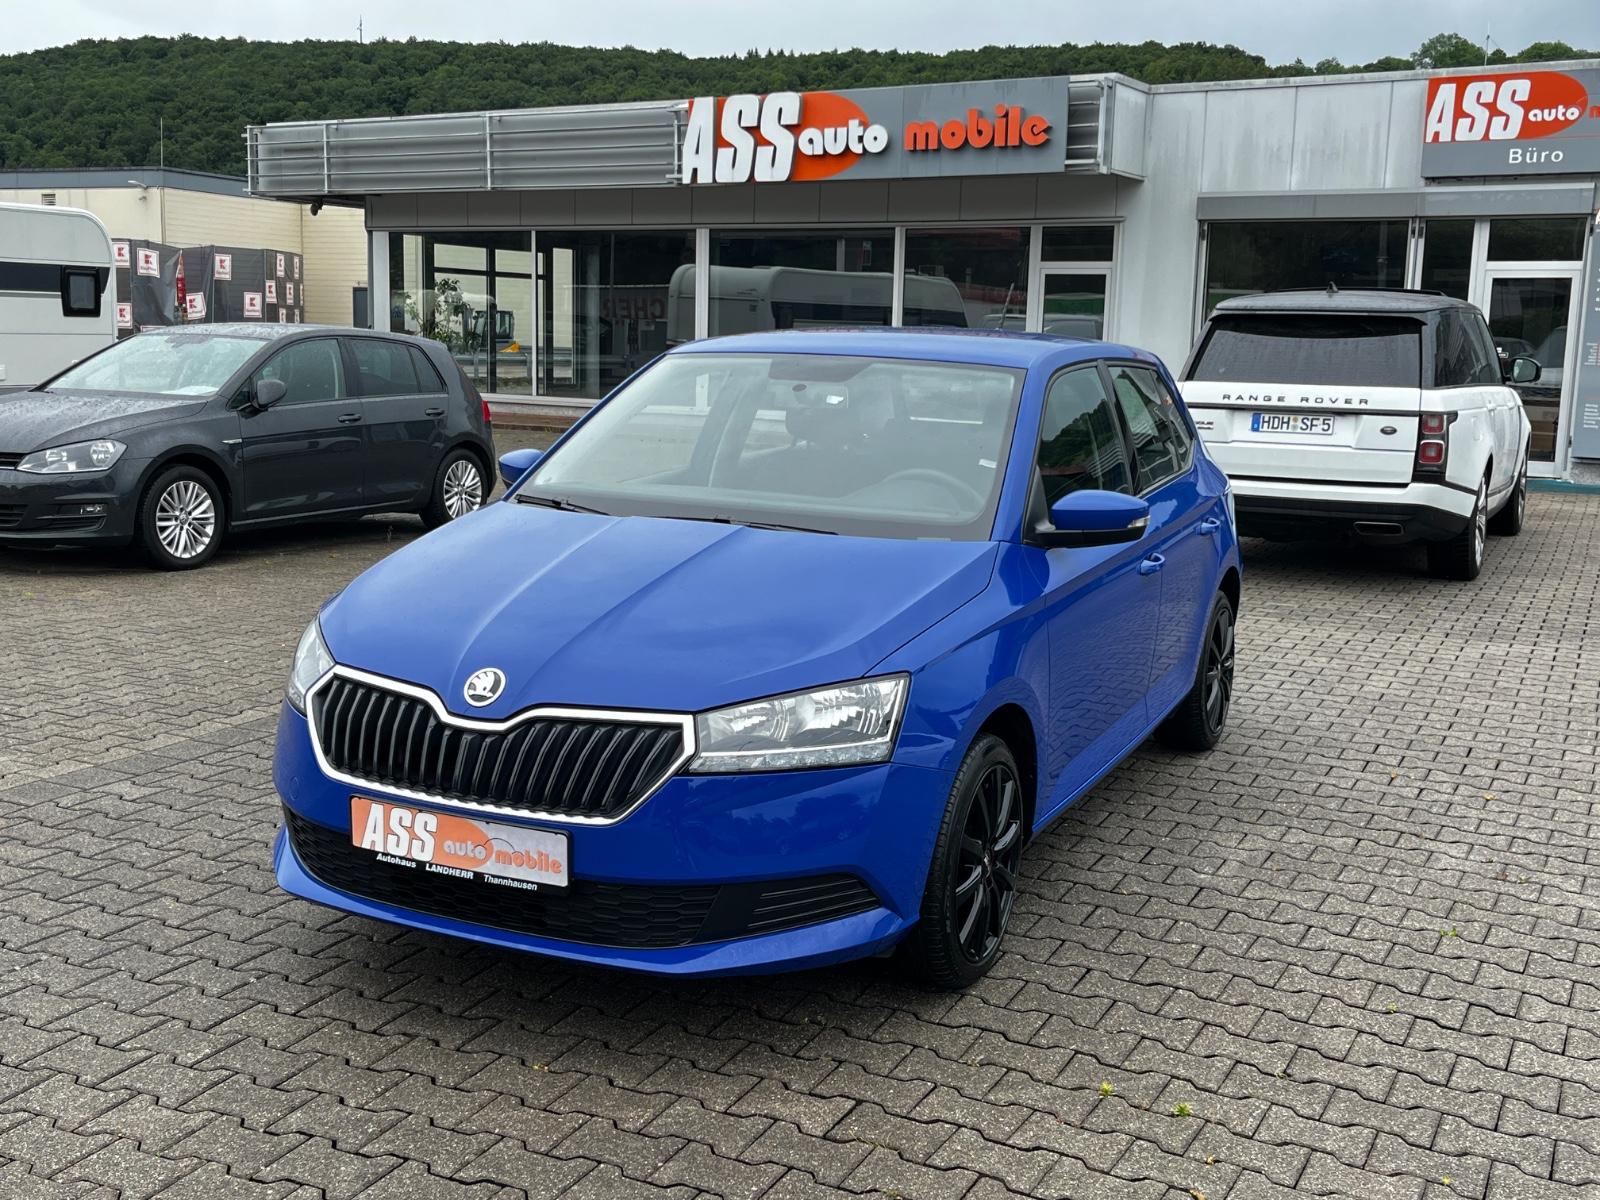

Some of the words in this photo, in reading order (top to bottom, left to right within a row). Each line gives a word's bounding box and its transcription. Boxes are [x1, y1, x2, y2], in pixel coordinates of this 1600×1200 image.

[1425, 79, 1531, 143] ASS
[1528, 105, 1580, 122] auto
[682, 92, 801, 184] ASS
[798, 119, 889, 155] auto
[904, 103, 1052, 152] mobile
[1508, 147, 1564, 164] Büro
[1222, 393, 1286, 403] RANGE
[1300, 396, 1369, 406] ROVER
[1261, 415, 1291, 431] HDH
[361, 802, 438, 862] ASS
[443, 838, 487, 861] auto
[495, 849, 562, 874] mobile
[376, 852, 417, 869] Autohaus
[425, 863, 474, 880] LANDHERR
[483, 873, 538, 891] Thannhausen
